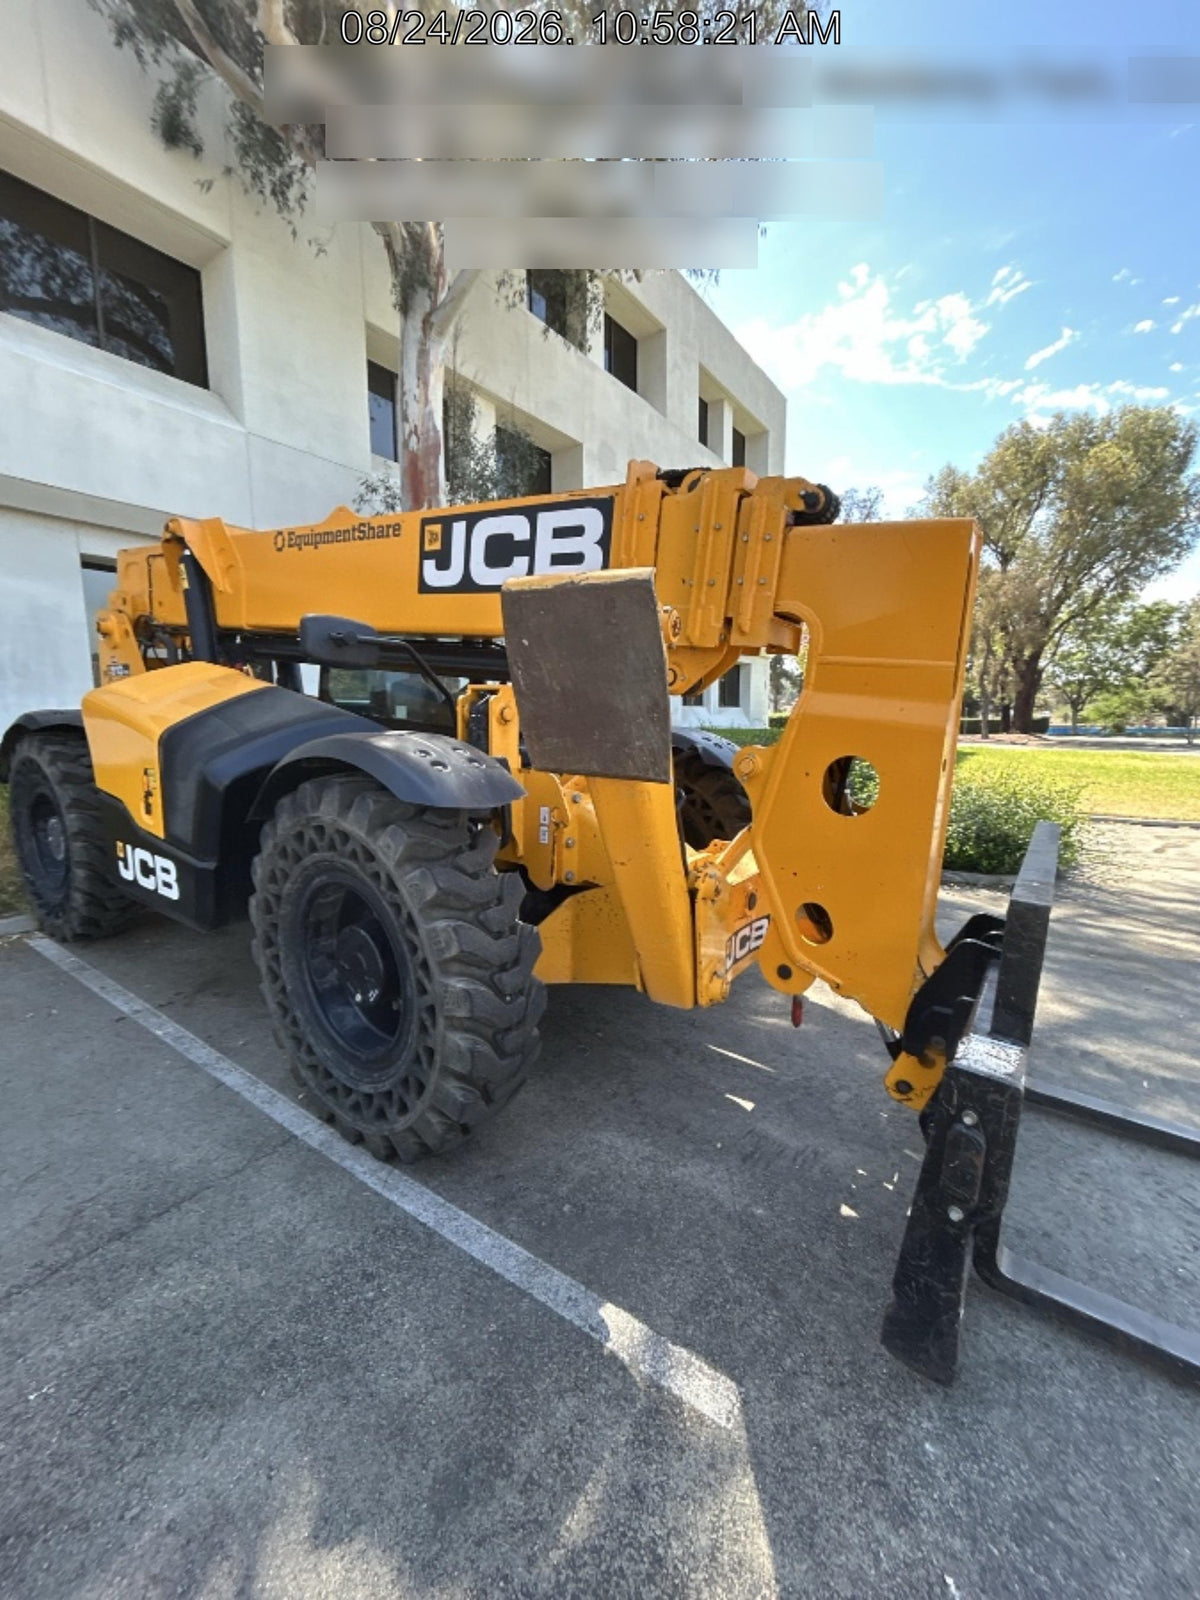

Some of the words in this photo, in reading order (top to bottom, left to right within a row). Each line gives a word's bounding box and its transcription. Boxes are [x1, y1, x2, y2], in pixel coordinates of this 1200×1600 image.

[287, 521, 402, 550] EquipmentShare
[422, 507, 603, 587] JCB
[118, 843, 180, 900] JCB
[726, 918, 769, 970] JCB
